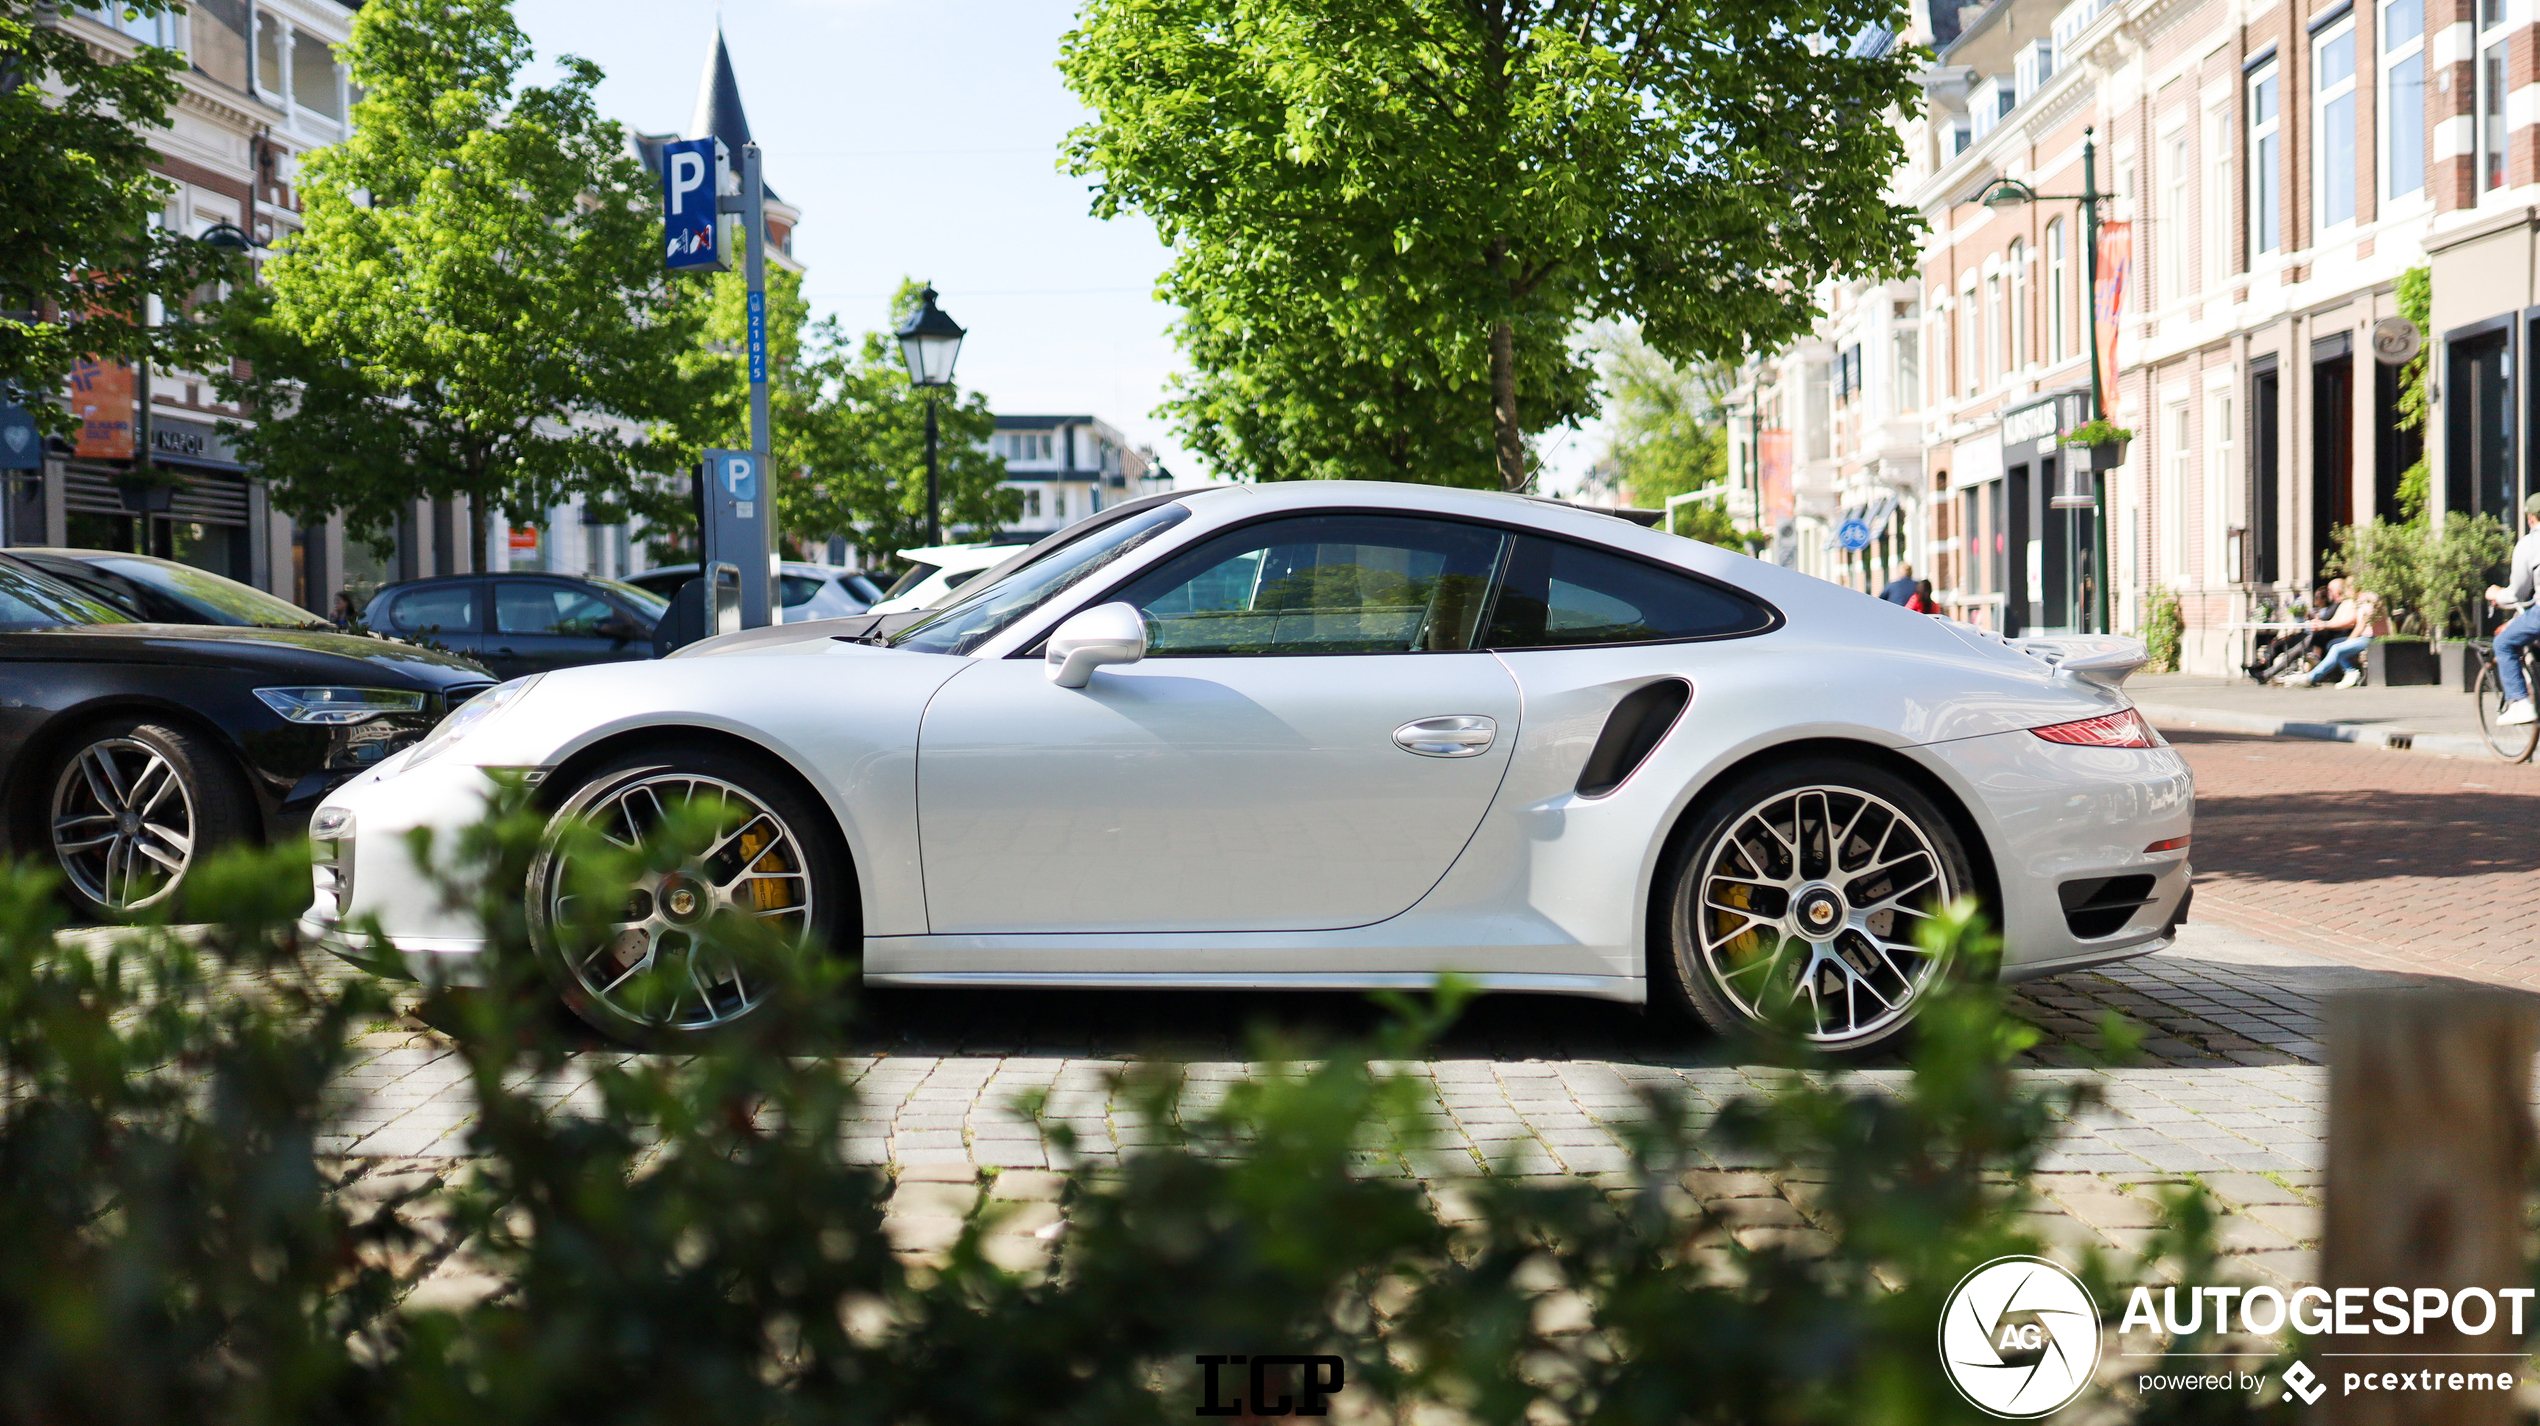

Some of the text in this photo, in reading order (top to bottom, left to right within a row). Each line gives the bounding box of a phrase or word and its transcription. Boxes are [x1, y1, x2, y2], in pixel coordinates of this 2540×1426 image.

[747, 149, 755, 158] 2
[671, 151, 705, 215] P
[752, 316, 761, 378] 21875
[729, 459, 750, 493] P
